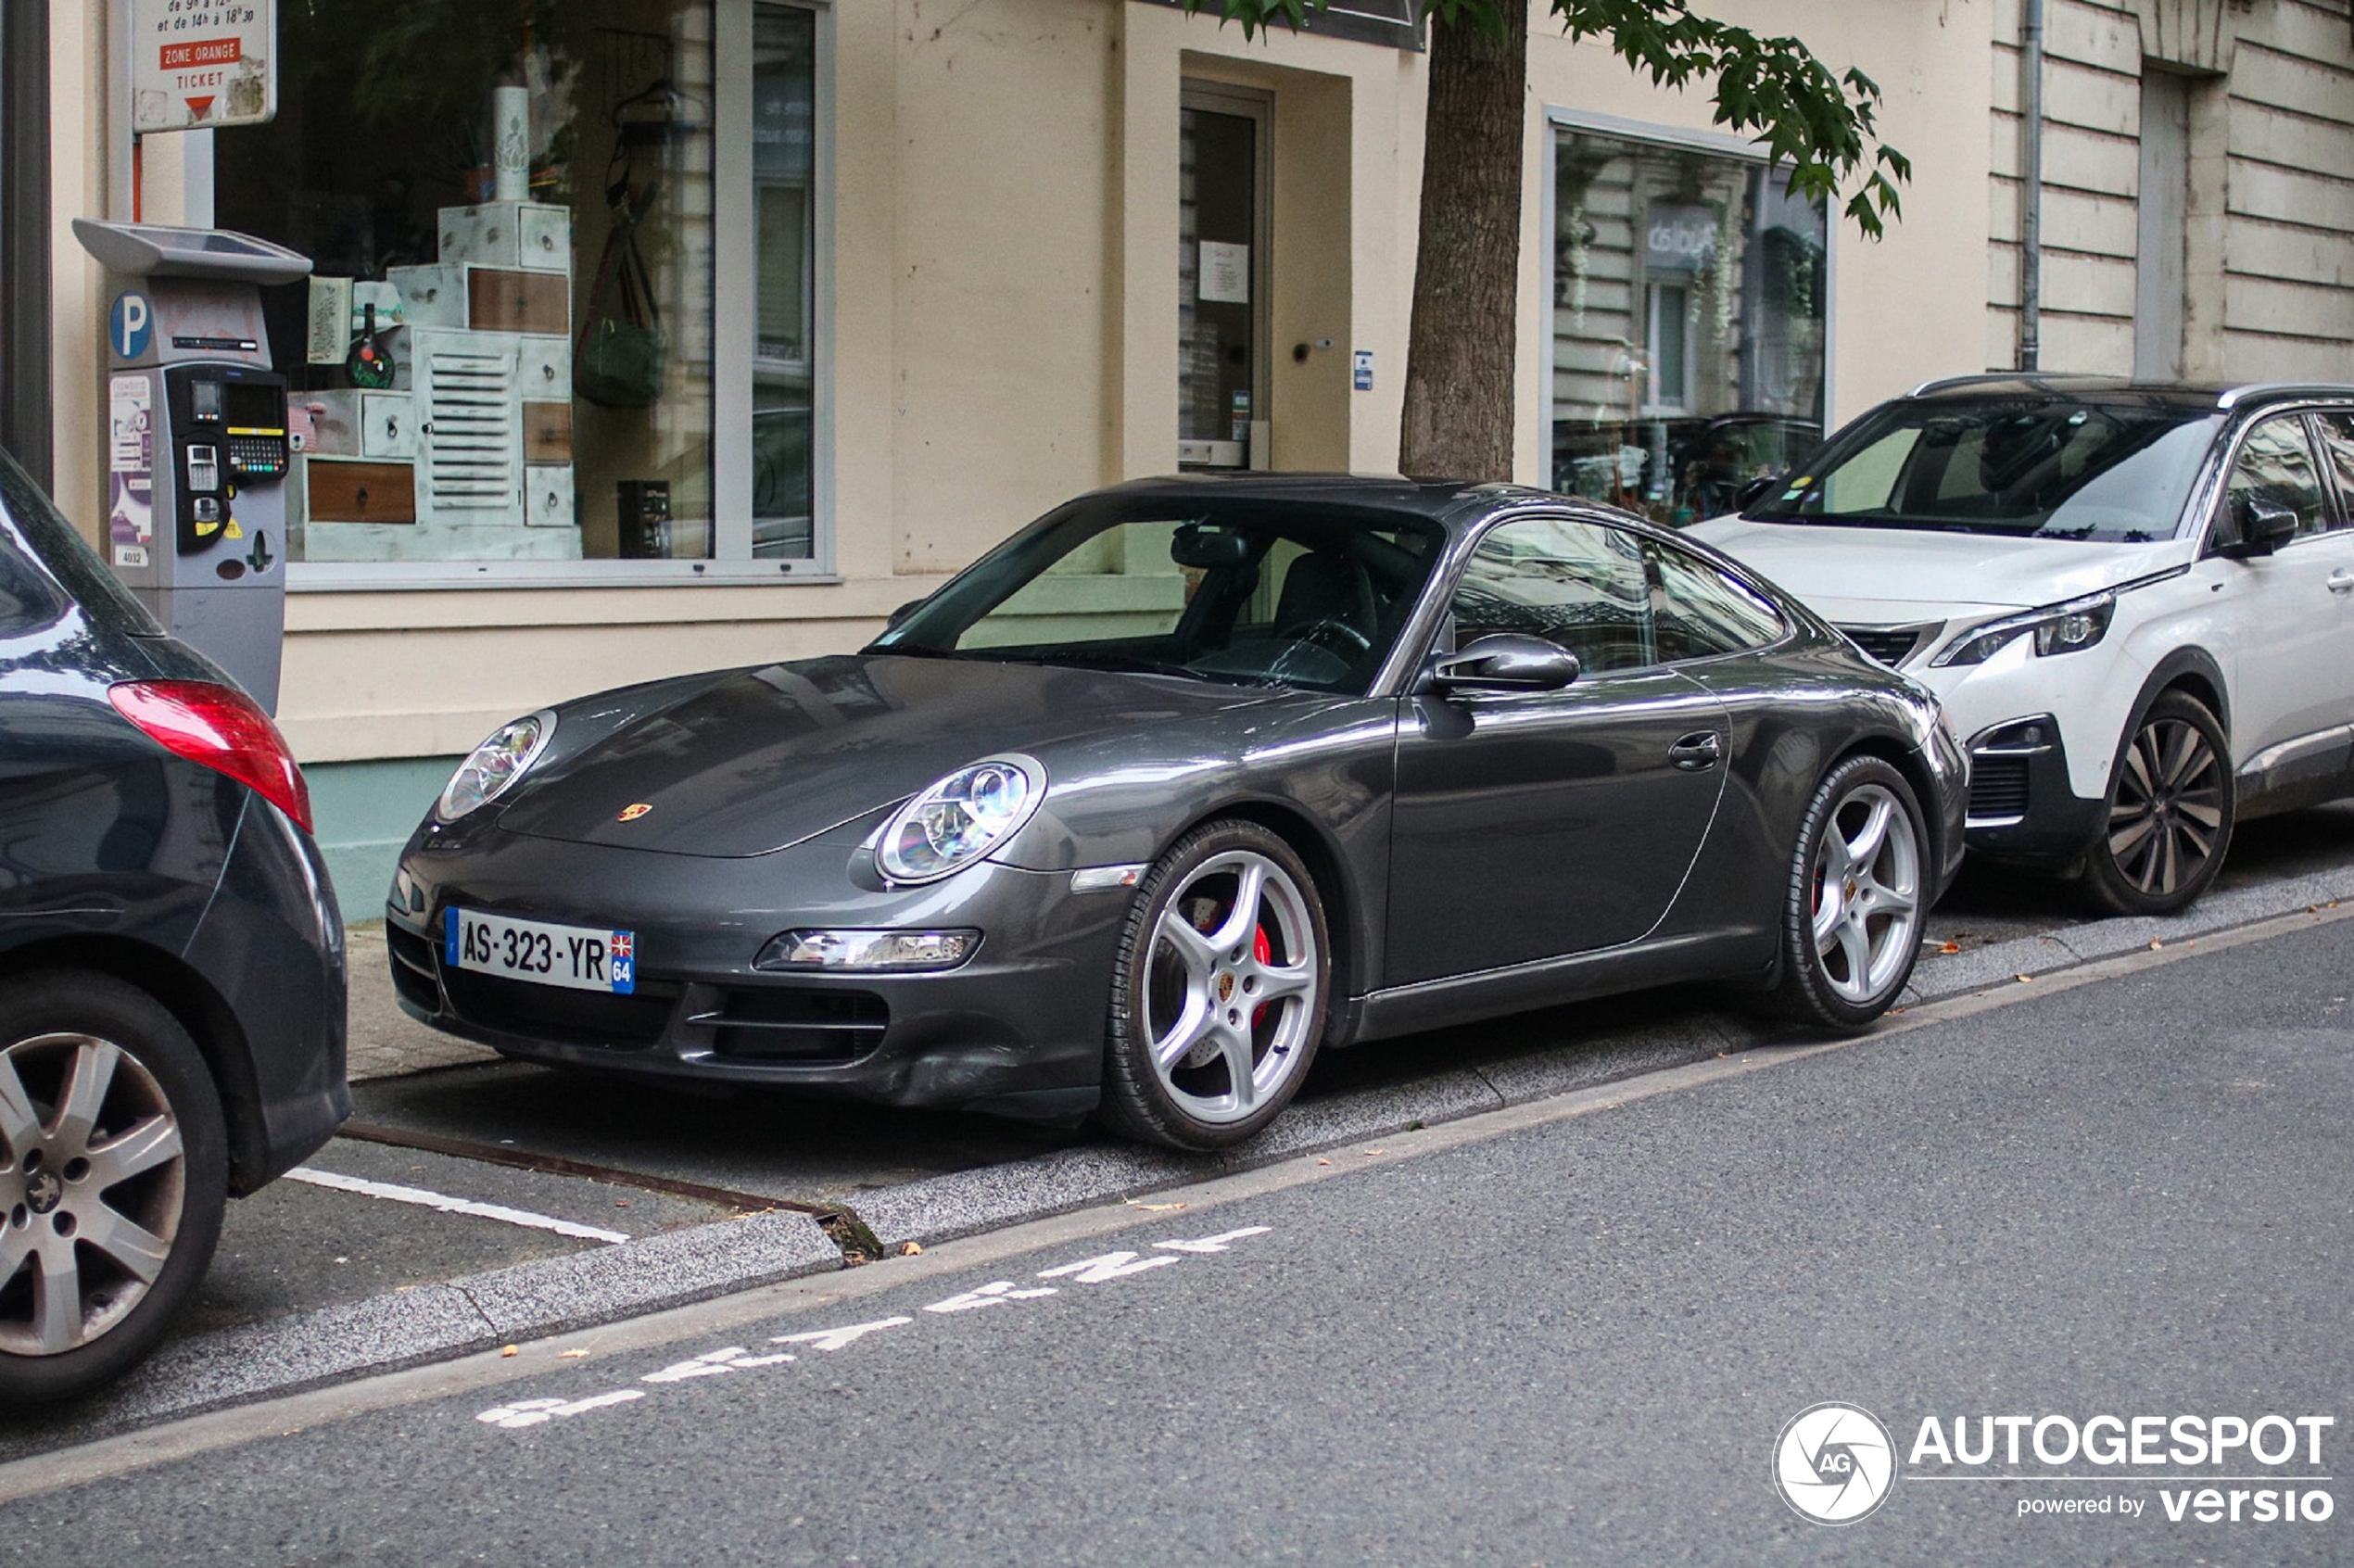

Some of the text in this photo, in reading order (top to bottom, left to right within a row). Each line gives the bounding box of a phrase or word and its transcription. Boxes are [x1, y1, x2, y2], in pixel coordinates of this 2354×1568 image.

[169, 0, 181, 12] de
[158, 19, 169, 32] et
[174, 17, 186, 30] de
[192, 13, 209, 28] 14h
[214, 12, 220, 26] à
[165, 43, 235, 64] ZONE ORANGE
[177, 71, 223, 90] TICKET
[122, 295, 147, 356] P
[464, 921, 605, 981] AS-323-YR
[613, 961, 631, 982] 64
